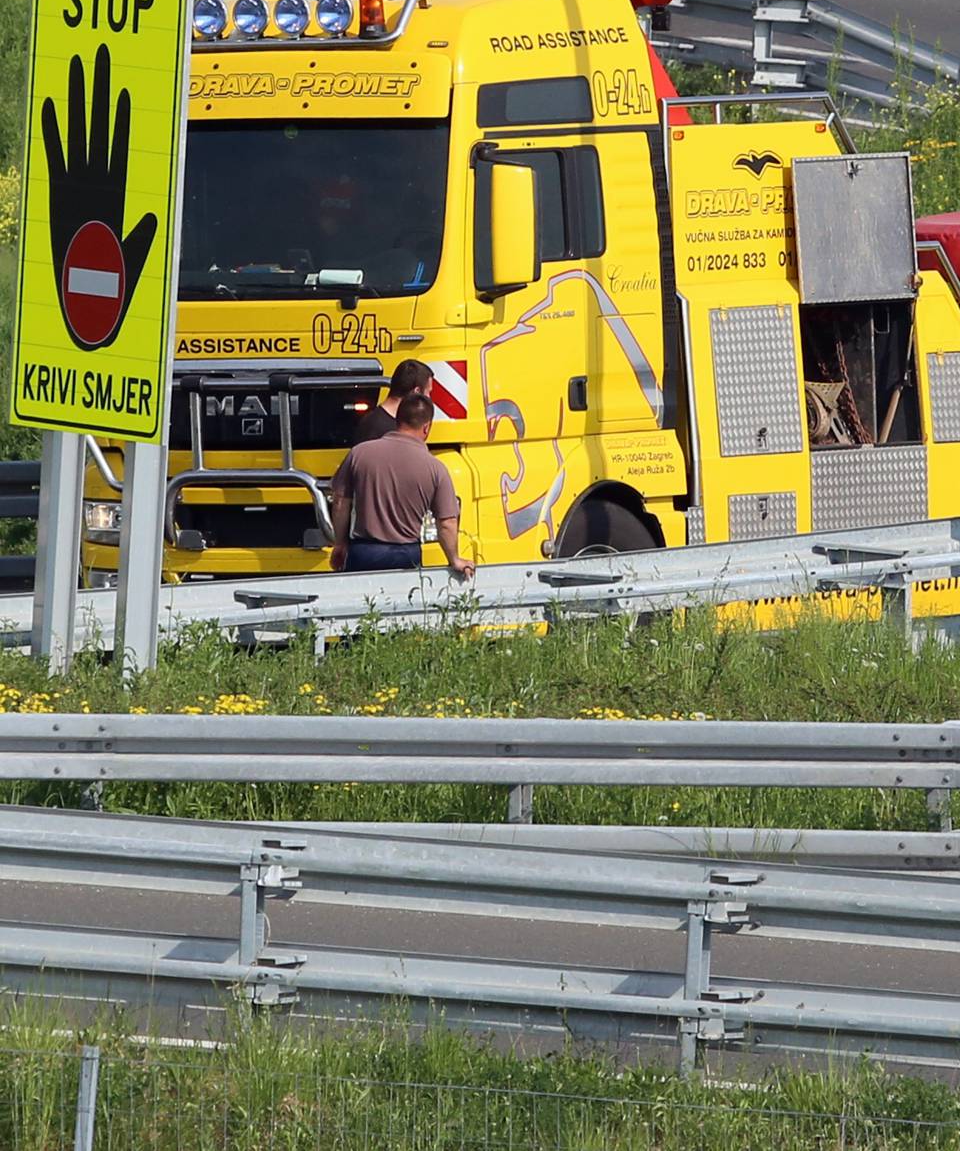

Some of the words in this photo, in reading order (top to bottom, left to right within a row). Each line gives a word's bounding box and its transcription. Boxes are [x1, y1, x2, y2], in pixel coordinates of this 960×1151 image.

[489, 35, 534, 53] ROAD
[538, 27, 629, 49] ASSISTANCE
[592, 68, 652, 117] 0-24h
[685, 228, 716, 243] VUČNA
[718, 228, 751, 242] SLUŽBA
[753, 229, 764, 240] ZA
[687, 253, 739, 272] 01/2024
[743, 251, 766, 268] 833
[606, 264, 657, 294] Croatia
[177, 338, 301, 354] ASSISTANCE
[312, 313, 393, 355] 0-24h
[22, 362, 77, 406] KRIVI
[82, 370, 153, 417] SMJER
[648, 451, 673, 461] Zagreb
[627, 466, 645, 477] Aleja
